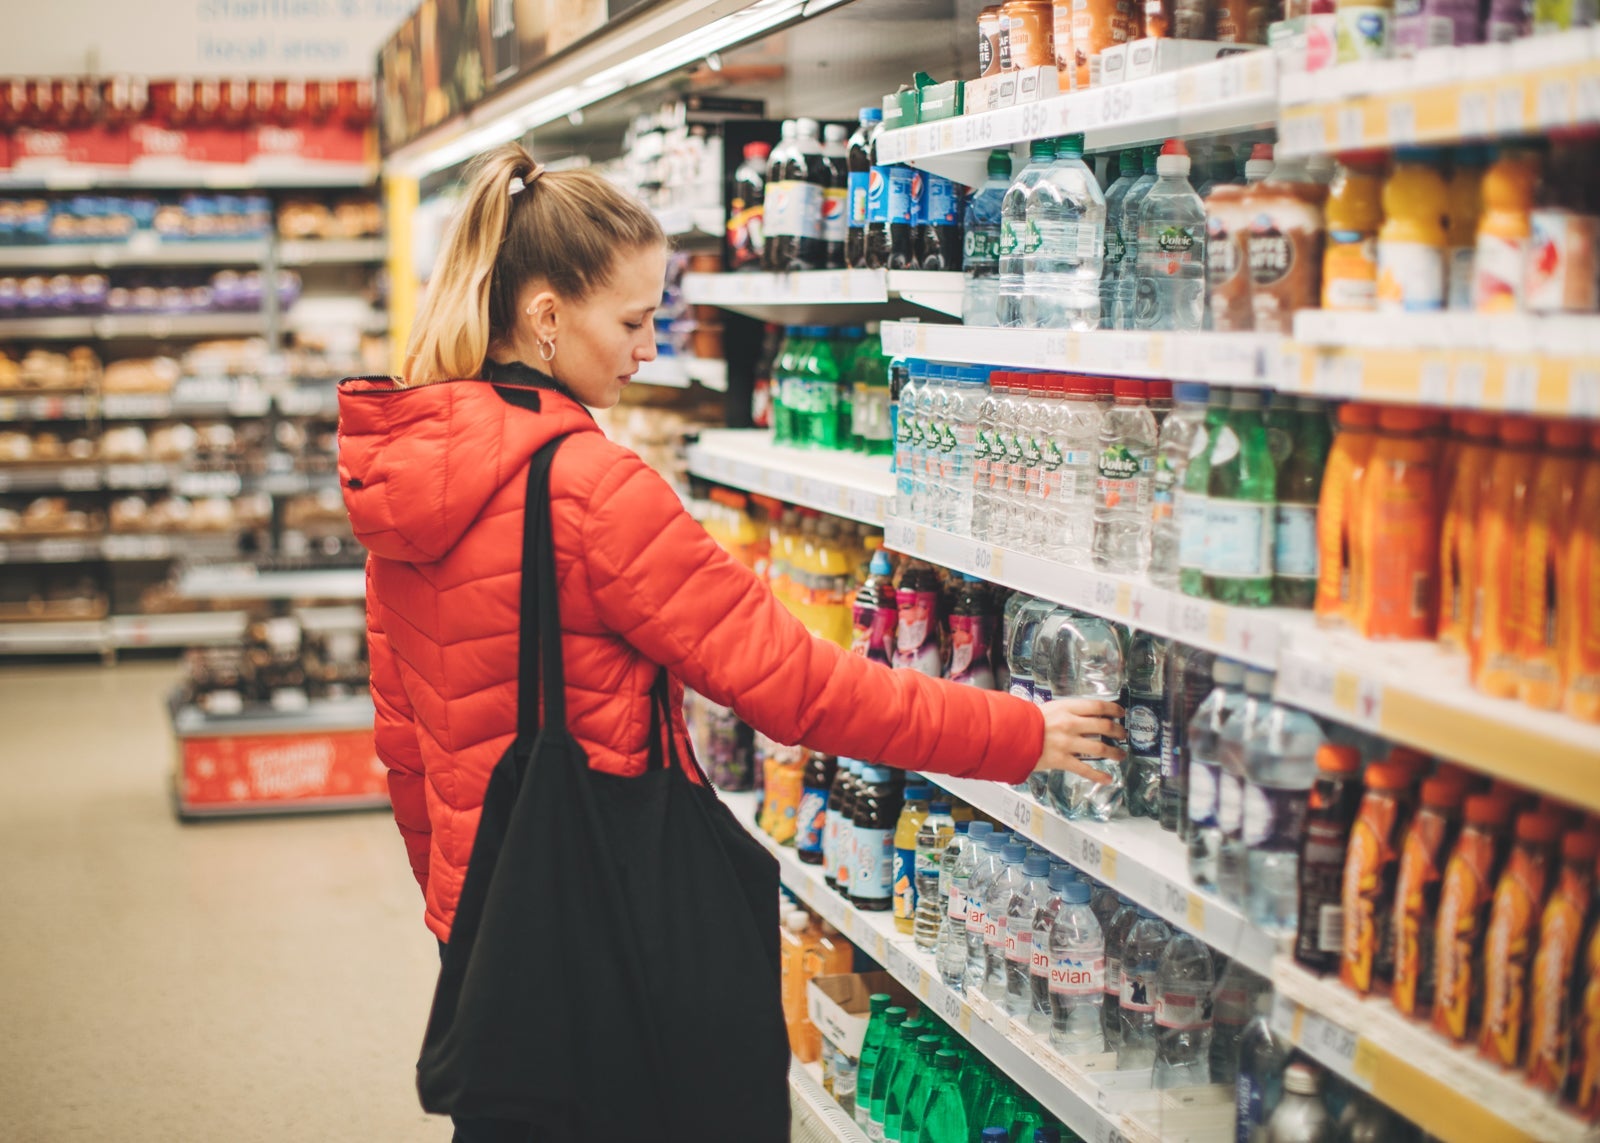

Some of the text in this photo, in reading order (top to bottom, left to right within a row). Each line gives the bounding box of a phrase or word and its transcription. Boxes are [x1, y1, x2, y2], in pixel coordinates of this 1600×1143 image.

[1022, 105, 1048, 136] 85p
[1099, 456, 1137, 471] Volvic
[1161, 720, 1173, 774] smart
[1013, 801, 1031, 826] 42p
[1082, 838, 1102, 865] 89p
[1051, 968, 1092, 984] evian
